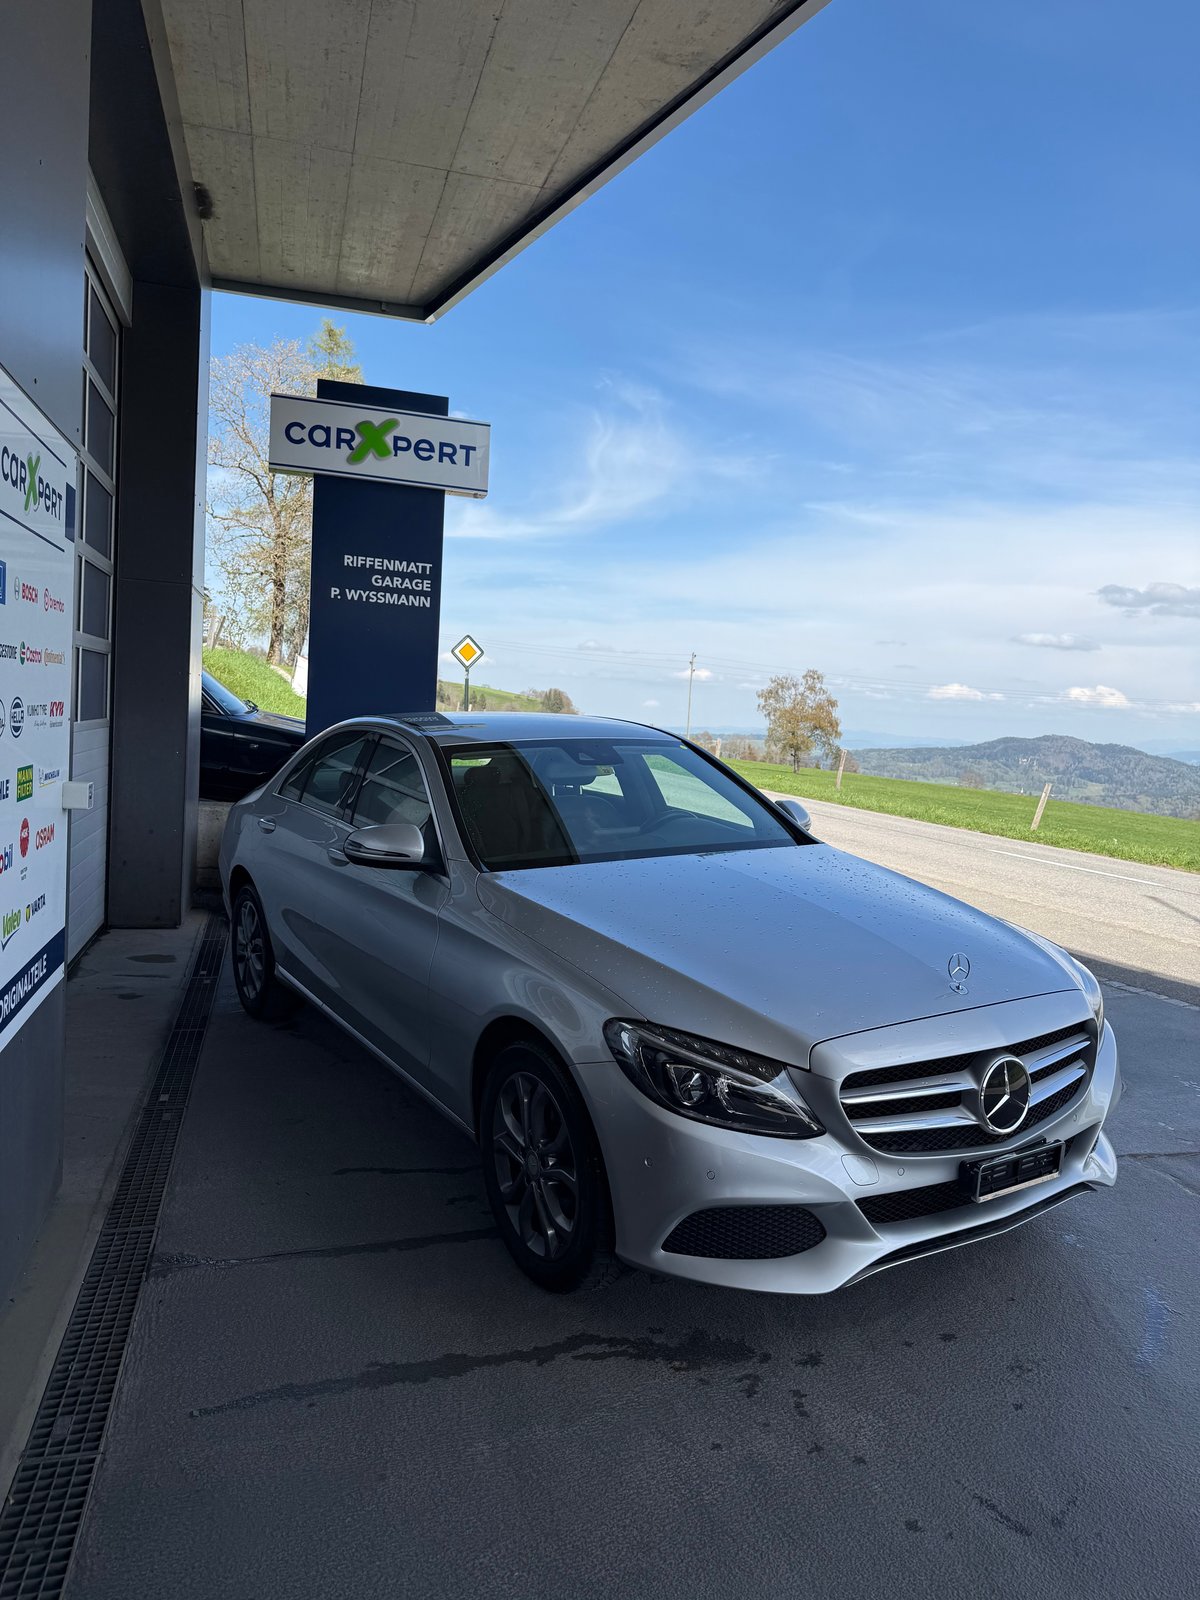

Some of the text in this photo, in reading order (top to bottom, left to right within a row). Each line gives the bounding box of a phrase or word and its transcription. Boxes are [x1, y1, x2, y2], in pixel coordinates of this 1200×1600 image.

[344, 554, 433, 575] RIFFENMATT
[371, 575, 432, 592] GARAGE
[22, 583, 38, 603] BOSCH
[330, 587, 431, 608] P. WYSSMANN
[26, 646, 42, 663] Castrol
[10, 709, 24, 724] HELLA
[50, 701, 64, 718] KYB
[18, 767, 33, 784] MANN
[44, 769, 60, 781] MICHELIN
[18, 782, 33, 799] FILTER
[36, 822, 54, 850] OSRAM
[31, 893, 46, 917] VARTA
[3, 908, 21, 939] Valeo
